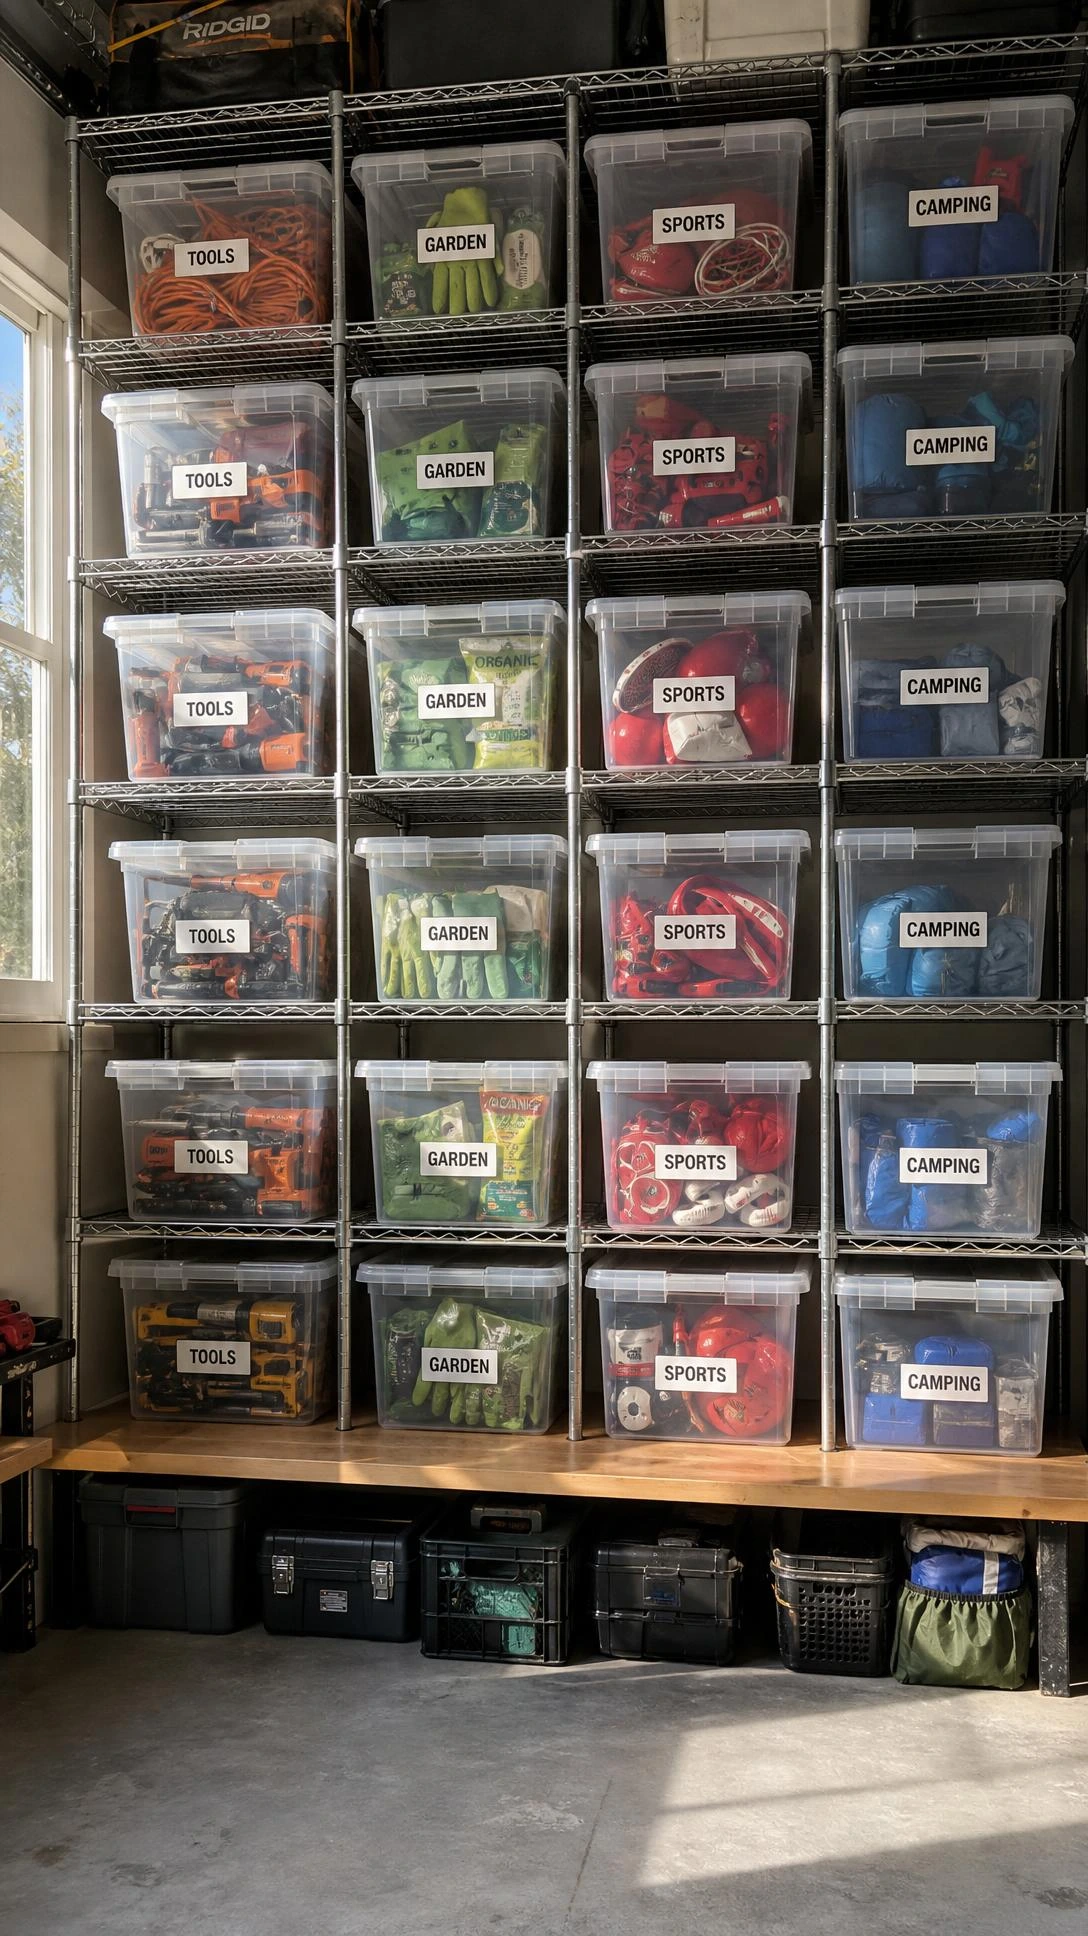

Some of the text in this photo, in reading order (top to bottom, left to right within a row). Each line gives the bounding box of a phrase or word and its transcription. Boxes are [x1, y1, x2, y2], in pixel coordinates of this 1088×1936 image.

[182, 13, 271, 40] RIDGID
[915, 195, 992, 217] CAMPING
[661, 213, 726, 234] SPORTS
[424, 233, 487, 253] GARDEN
[187, 247, 235, 267] TOOLS
[913, 435, 988, 455] CAMPING
[662, 446, 726, 466] SPORTS
[424, 460, 486, 480] GARDEN
[185, 471, 233, 489] TOOLS
[475, 653, 541, 669] ORGANIC
[662, 685, 725, 704] SPORTS
[907, 676, 982, 695] CAMPING
[186, 700, 234, 717] TOOLS
[425, 692, 486, 710] GARDEN
[188, 928, 236, 944] TOOLS
[428, 925, 489, 941] GARDEN
[663, 923, 726, 940] SPORTS
[906, 920, 981, 938] CAMPING
[186, 1148, 234, 1165] TOOLS
[427, 1151, 488, 1167] GARDEN
[664, 1153, 727, 1171] SPORTS
[906, 1157, 980, 1174] CAMPING
[189, 1348, 237, 1366] TOOLS
[429, 1356, 490, 1374] GARDEN
[664, 1364, 727, 1383] SPORTS
[908, 1373, 981, 1392] CAMPING
